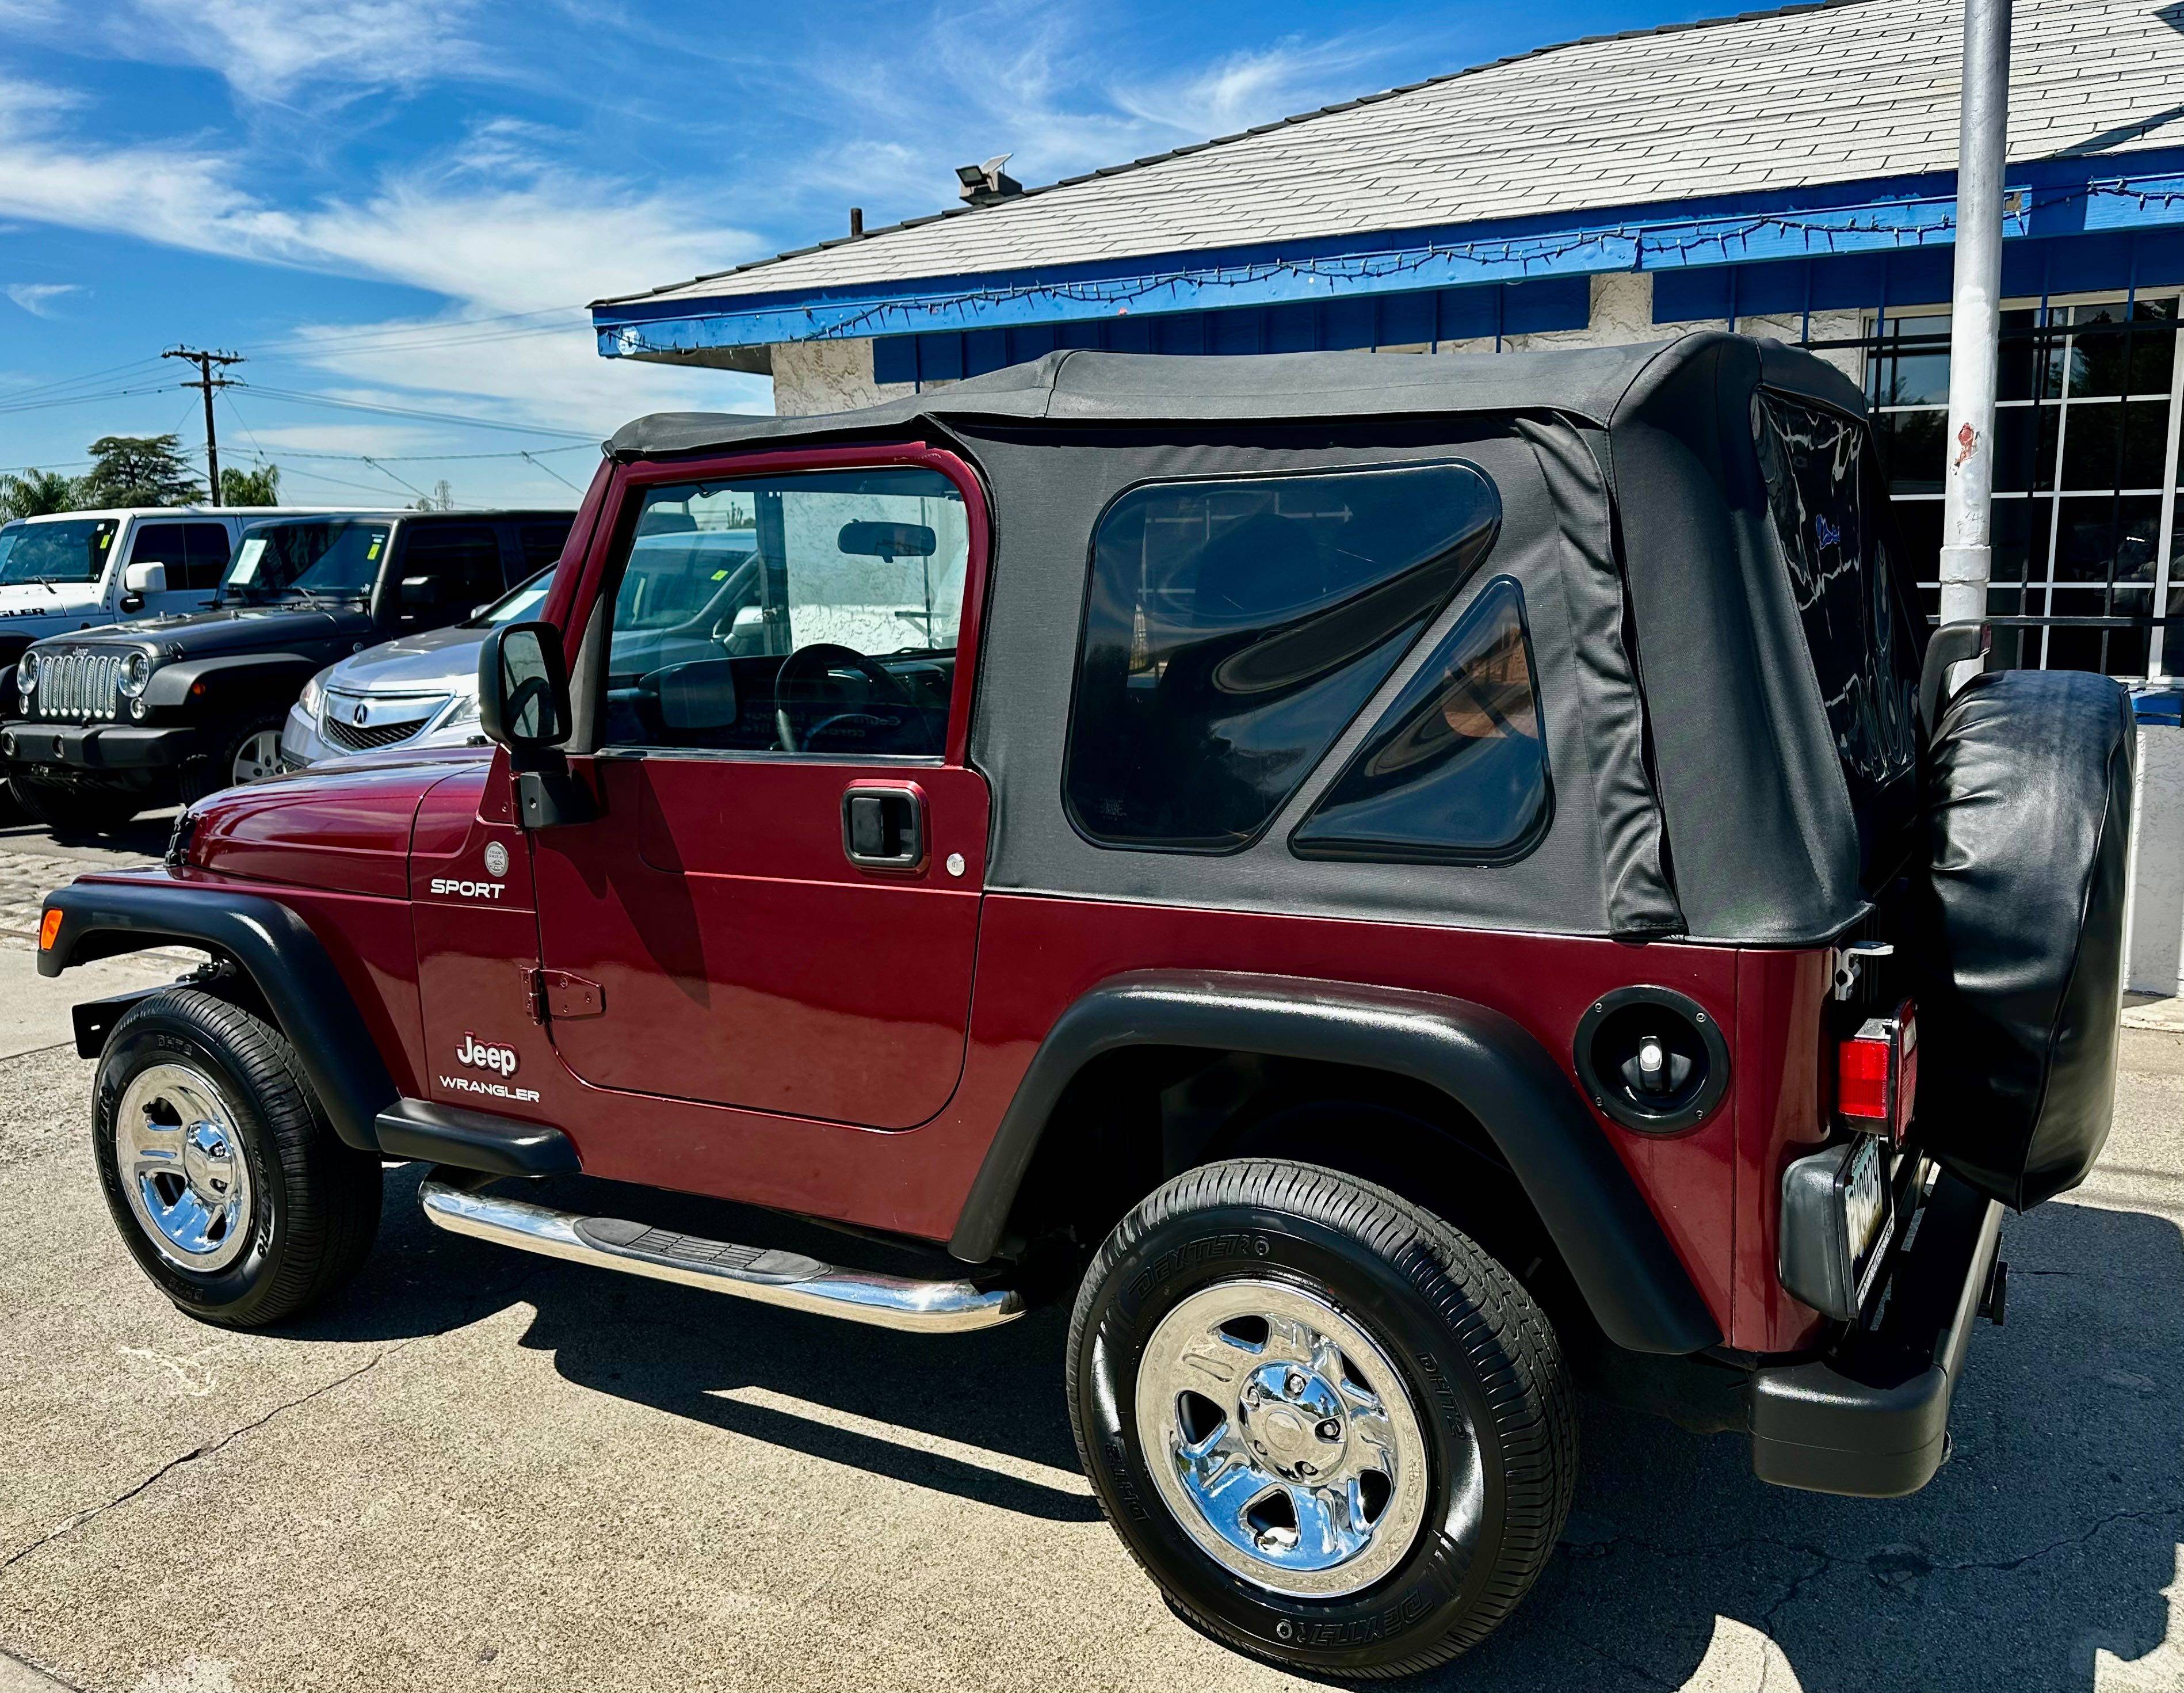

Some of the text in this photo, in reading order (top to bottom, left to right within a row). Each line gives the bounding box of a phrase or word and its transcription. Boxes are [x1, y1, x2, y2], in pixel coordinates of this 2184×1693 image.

[430, 879, 505, 898] SPORT
[457, 1035, 516, 1077] Jeep
[439, 1075, 540, 1103] WRANGLER
[1128, 1233, 1272, 1299] DEXTERO
